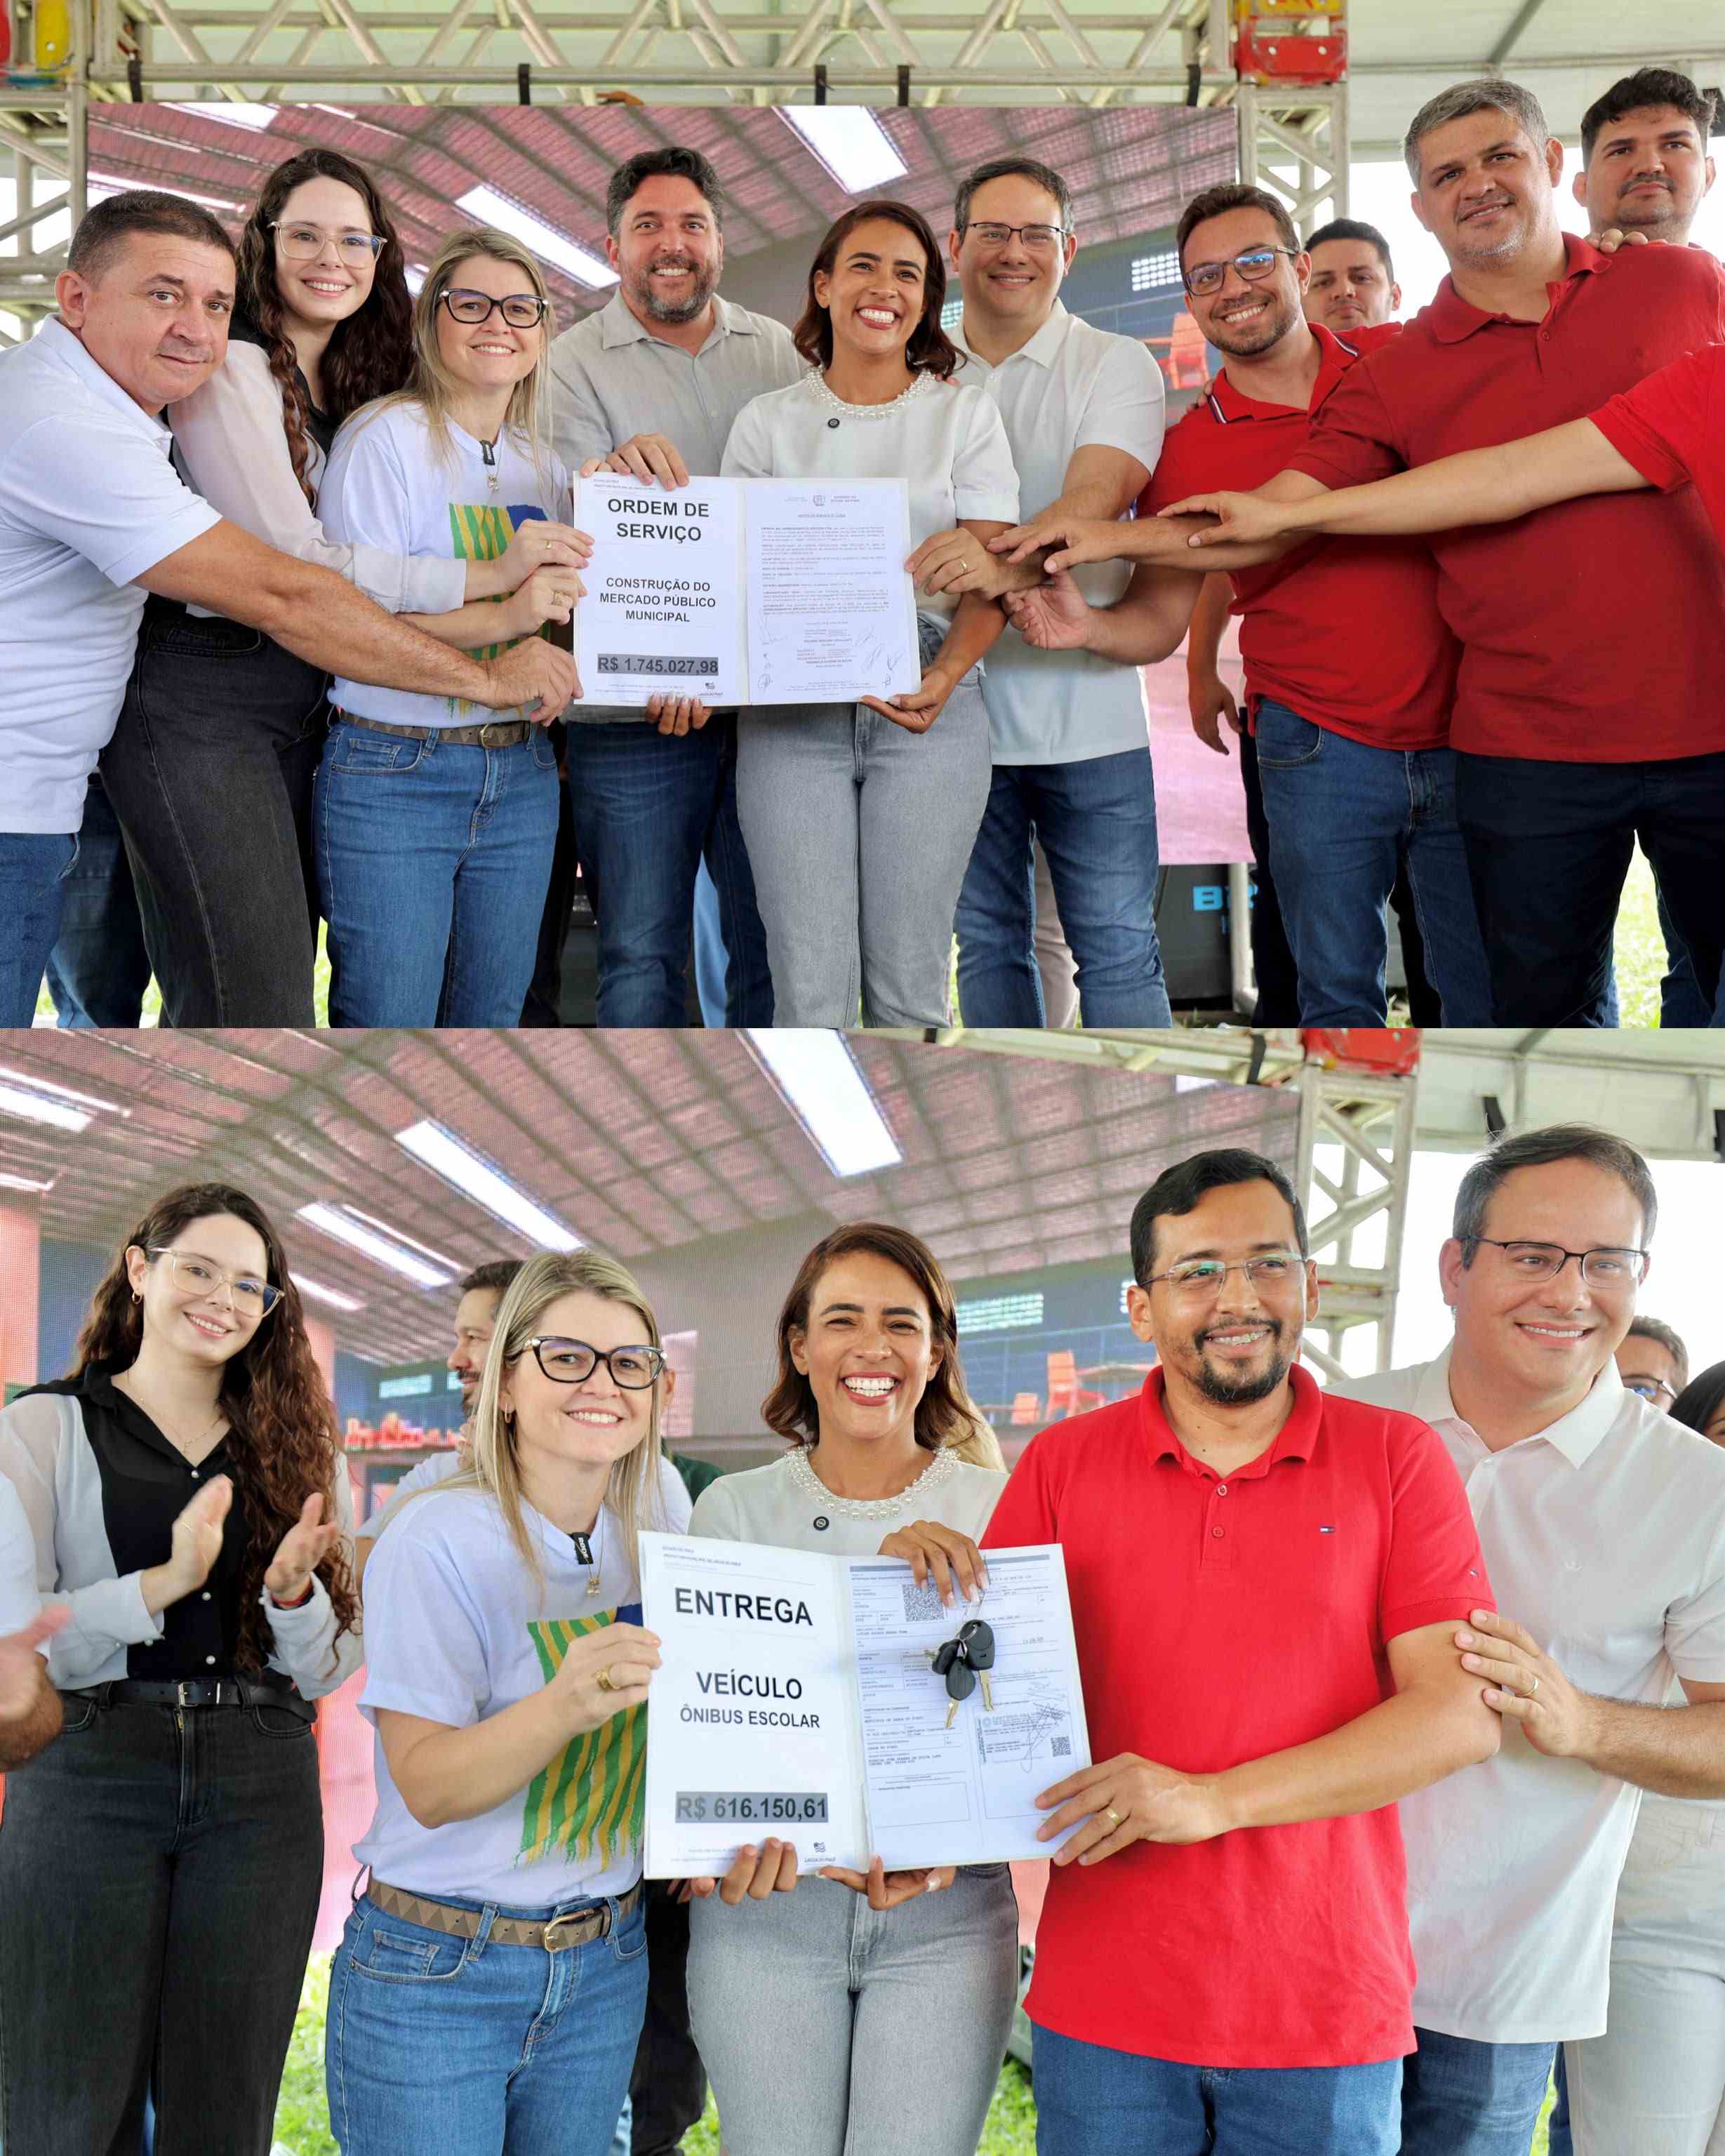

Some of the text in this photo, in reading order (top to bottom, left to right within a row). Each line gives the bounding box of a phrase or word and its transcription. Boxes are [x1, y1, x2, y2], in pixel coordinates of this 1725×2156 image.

[608, 498, 710, 518] ORDEM DE
[616, 522, 702, 543] SERVIÇO
[606, 576, 711, 592] CONSTRUÇÃO DO
[599, 592, 717, 608] MERCADO PÚBLICO
[625, 610, 691, 623] MUNICIPAL
[597, 656, 719, 675] R$ 1.745.027,98
[676, 1588, 813, 1626] ENTREGA
[695, 1668, 803, 1700] VEÍCULO
[679, 1703, 820, 1729] ÔNIBUS ESCOLAR
[676, 1797, 826, 1822] R$ 616.150,61
